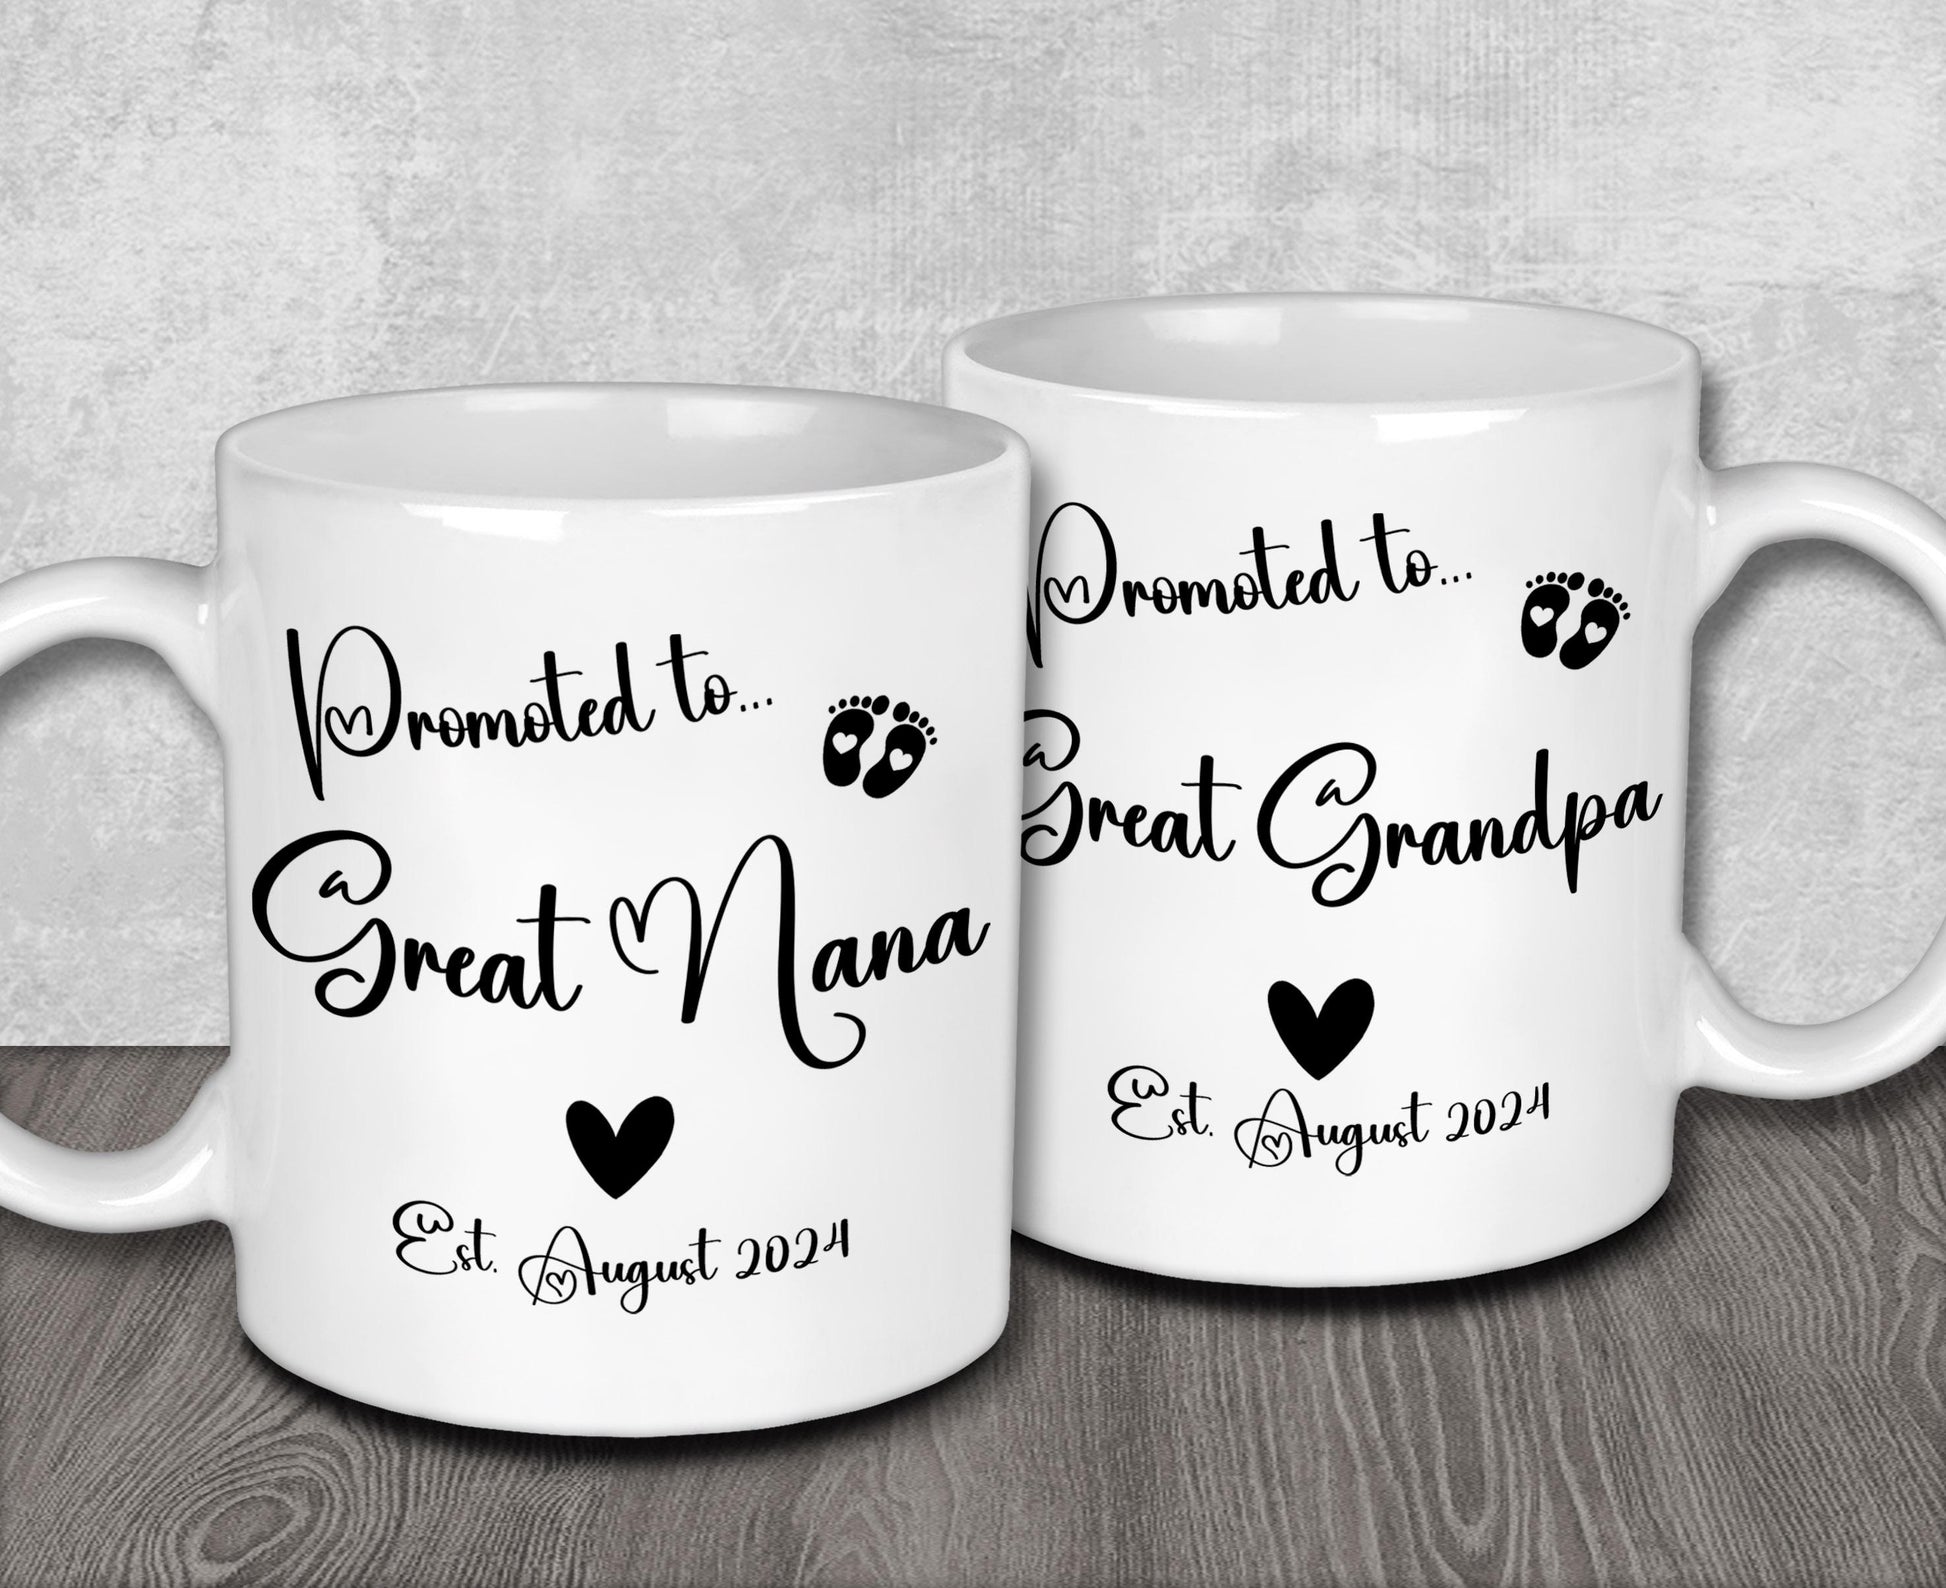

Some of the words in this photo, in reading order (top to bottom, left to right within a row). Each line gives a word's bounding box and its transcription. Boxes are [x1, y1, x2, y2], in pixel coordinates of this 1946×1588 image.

[1026, 501, 1360, 668] Promoted
[286, 625, 656, 802] Promoted
[1256, 742, 1664, 908] Grandpa
[251, 829, 591, 1018] Great
[609, 834, 991, 1070] Nana
[1107, 1065, 1213, 1141] Est.
[1233, 1088, 1433, 1177] August
[1445, 1082, 1550, 1142] 2024
[392, 1200, 497, 1276] Est.
[518, 1225, 722, 1315] August
[735, 1218, 849, 1280] 2024
